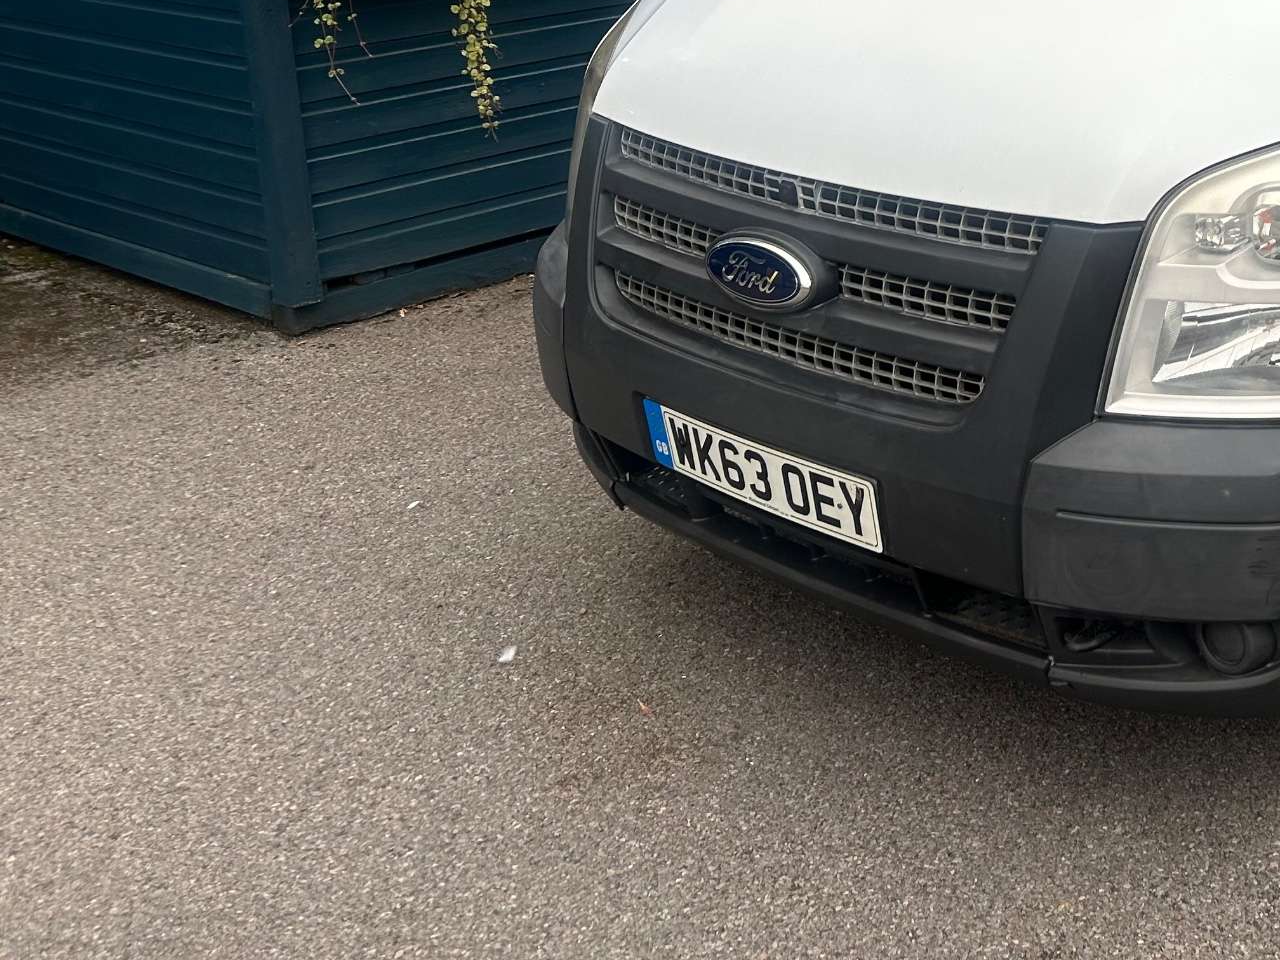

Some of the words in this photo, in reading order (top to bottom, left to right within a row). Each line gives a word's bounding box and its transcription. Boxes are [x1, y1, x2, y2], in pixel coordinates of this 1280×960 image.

[722, 250, 778, 294] Ford
[668, 417, 772, 502] WK63
[782, 463, 864, 536] OEY
